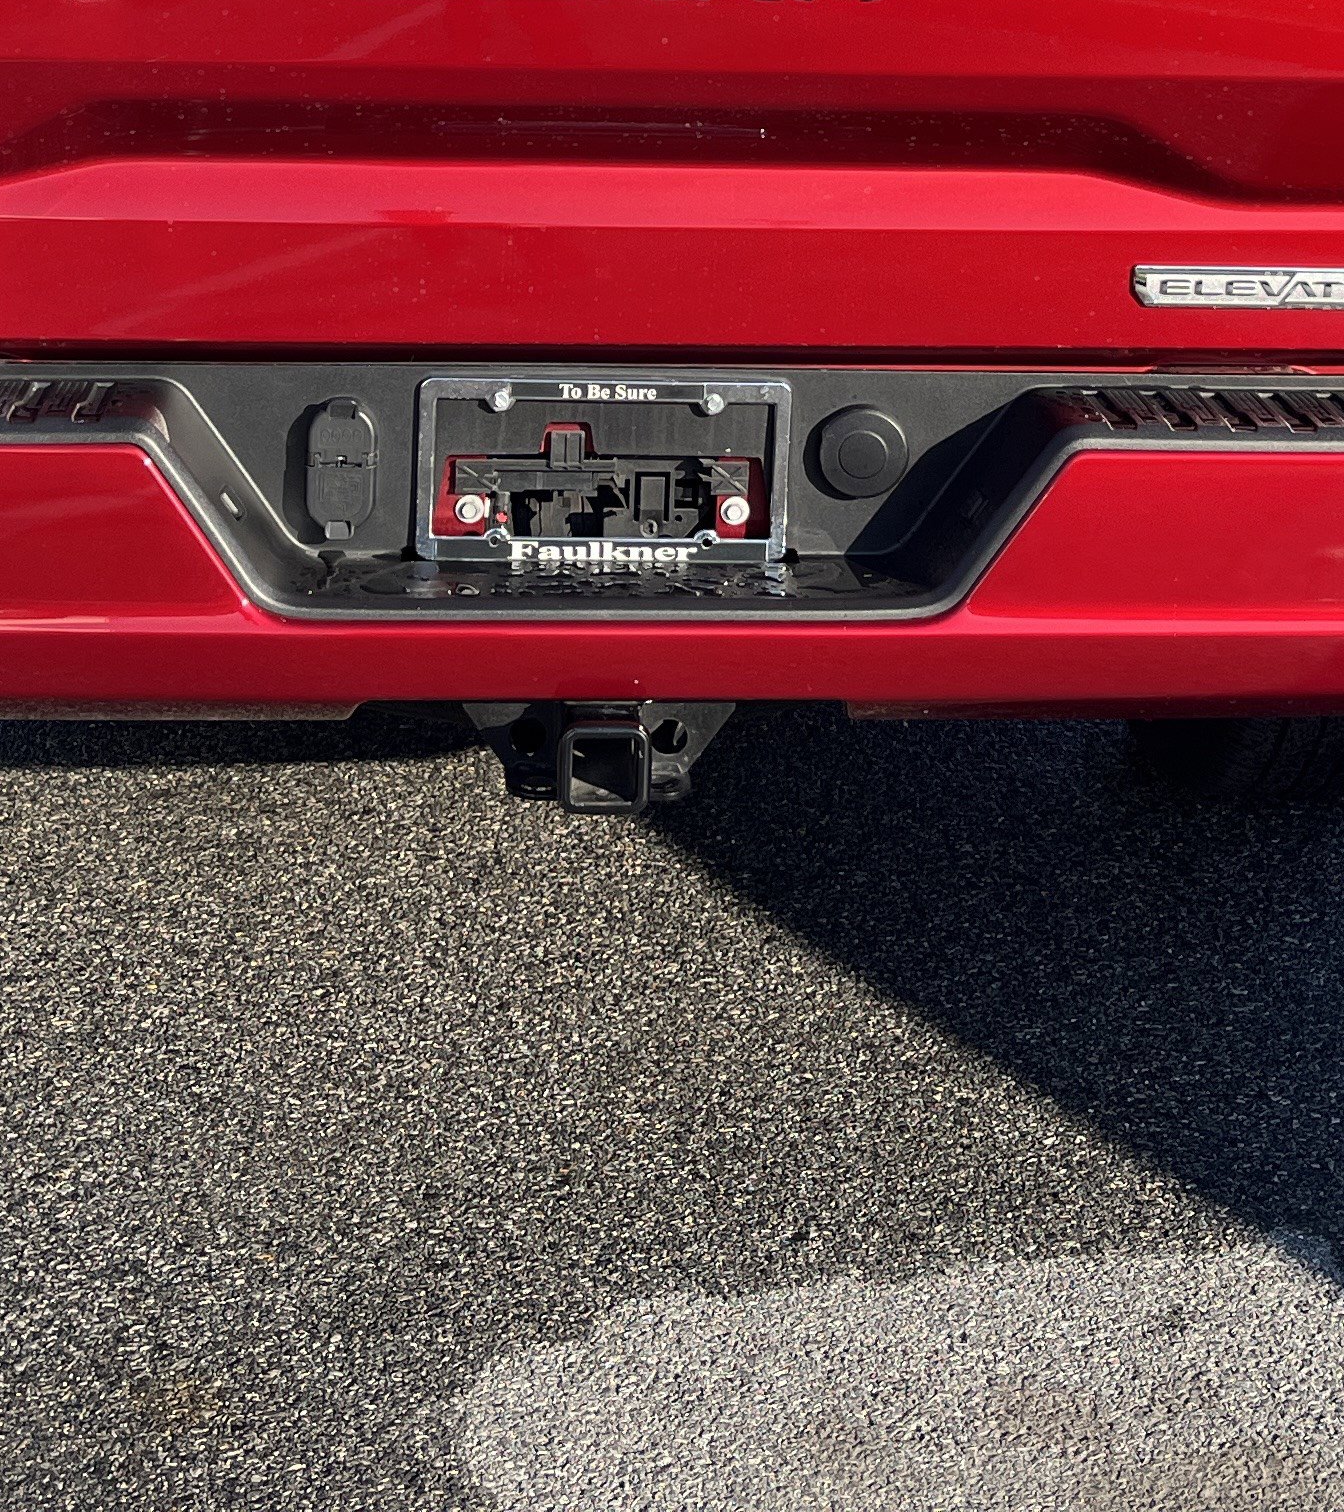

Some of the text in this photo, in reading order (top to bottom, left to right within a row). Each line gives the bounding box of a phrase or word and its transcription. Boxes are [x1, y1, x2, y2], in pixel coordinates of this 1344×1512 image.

[558, 383, 658, 401] To Be Sure
[506, 540, 698, 563] Faulkner
